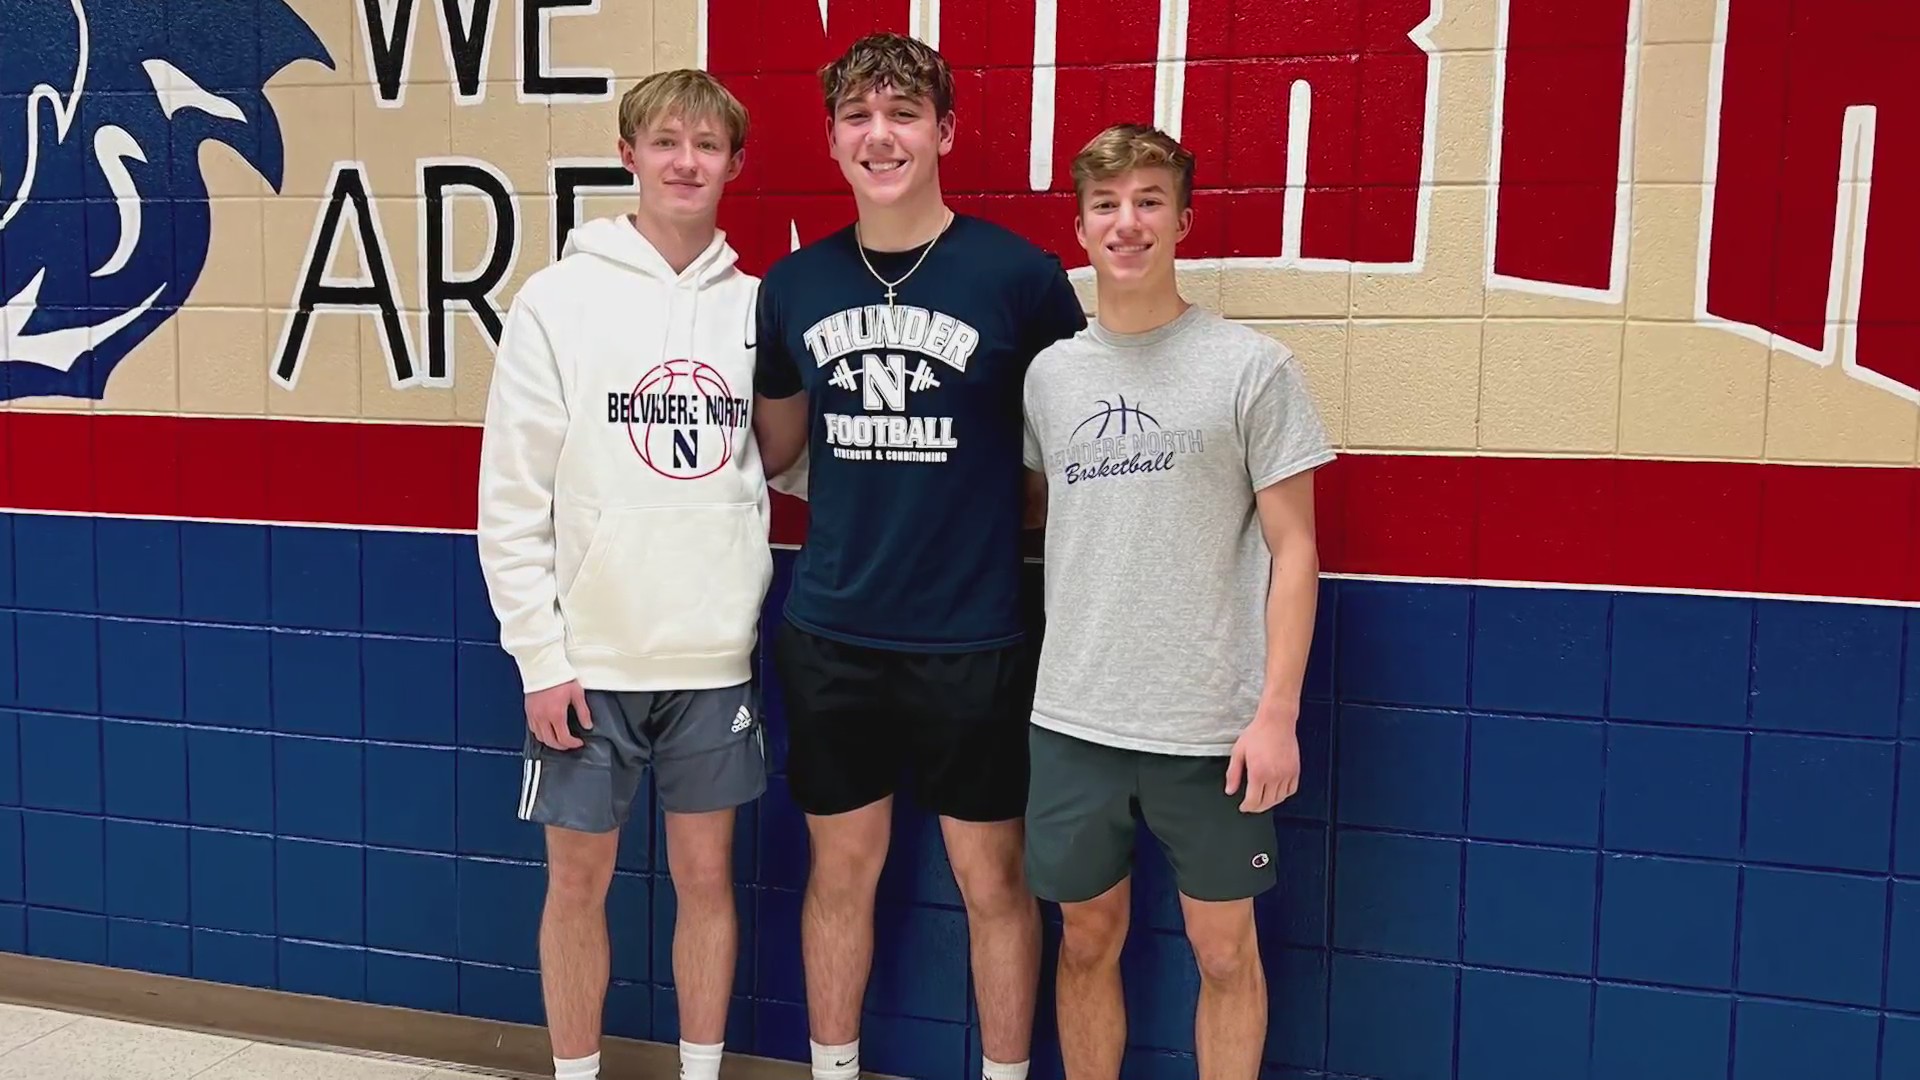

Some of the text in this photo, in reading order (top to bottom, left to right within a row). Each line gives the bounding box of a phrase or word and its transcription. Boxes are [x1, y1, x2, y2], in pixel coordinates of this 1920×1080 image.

[803, 304, 980, 373] THUNDER
[862, 354, 905, 411] N
[608, 392, 749, 428] BELVIDERE NORTH
[673, 429, 698, 468] N
[824, 413, 958, 449] FOOTBALL
[1132, 429, 1204, 456] NORTH
[833, 447, 947, 462] STRENGTH & CONDITIONING
